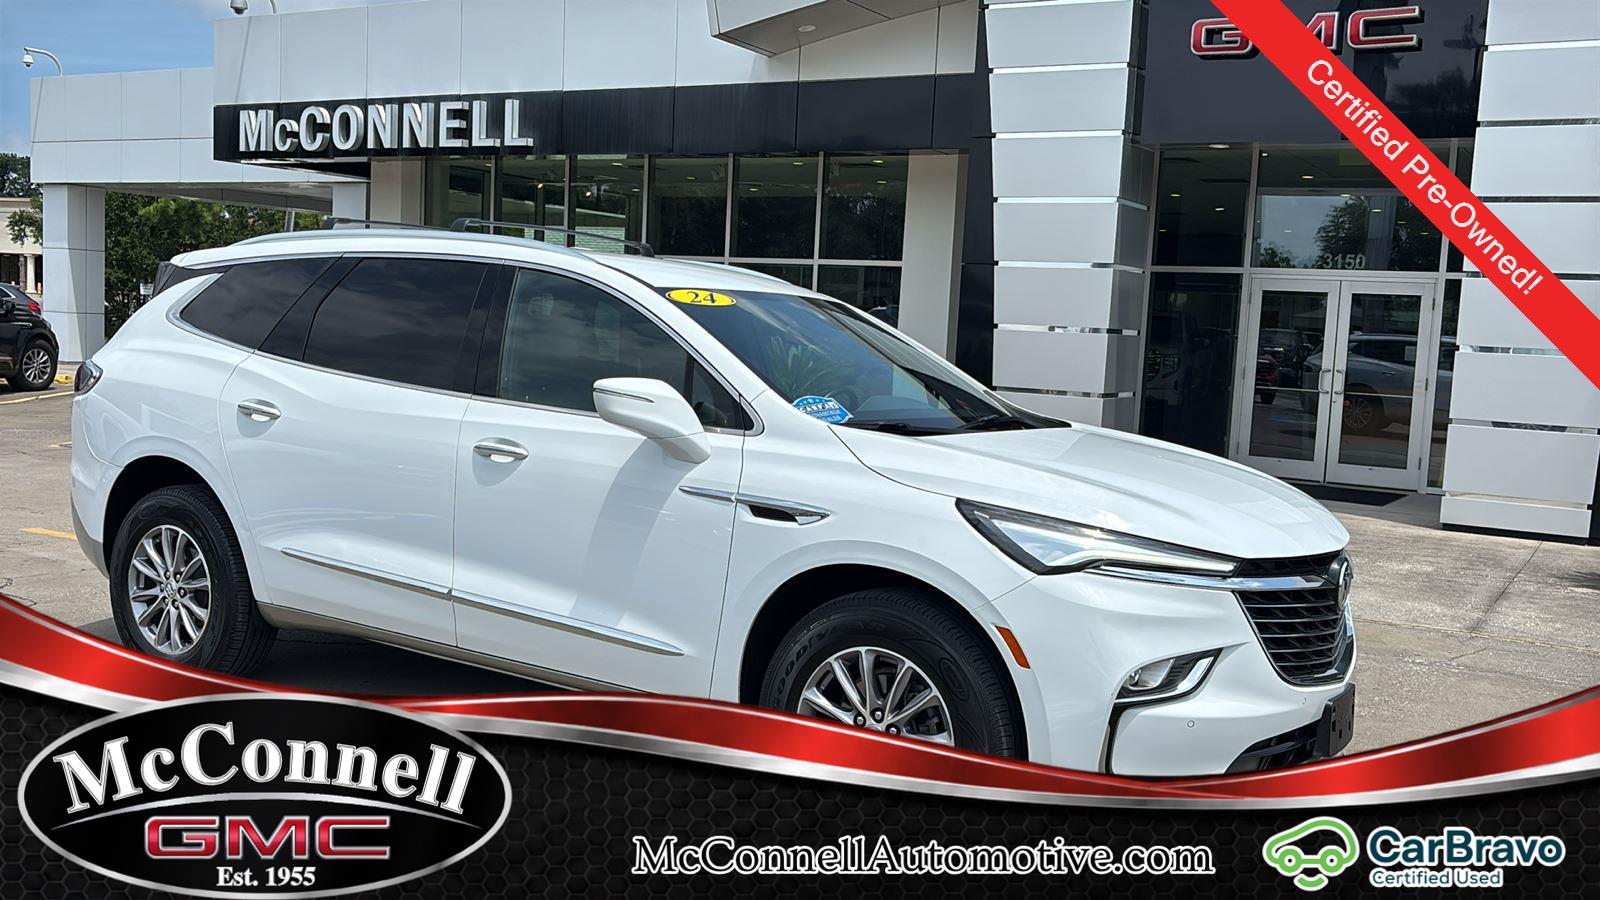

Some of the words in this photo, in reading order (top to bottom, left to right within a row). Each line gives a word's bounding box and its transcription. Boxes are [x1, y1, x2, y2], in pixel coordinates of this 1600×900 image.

[238, 98, 534, 152] McCONNELL
[1322, 253, 1366, 270] 3150
[686, 291, 716, 304] 24
